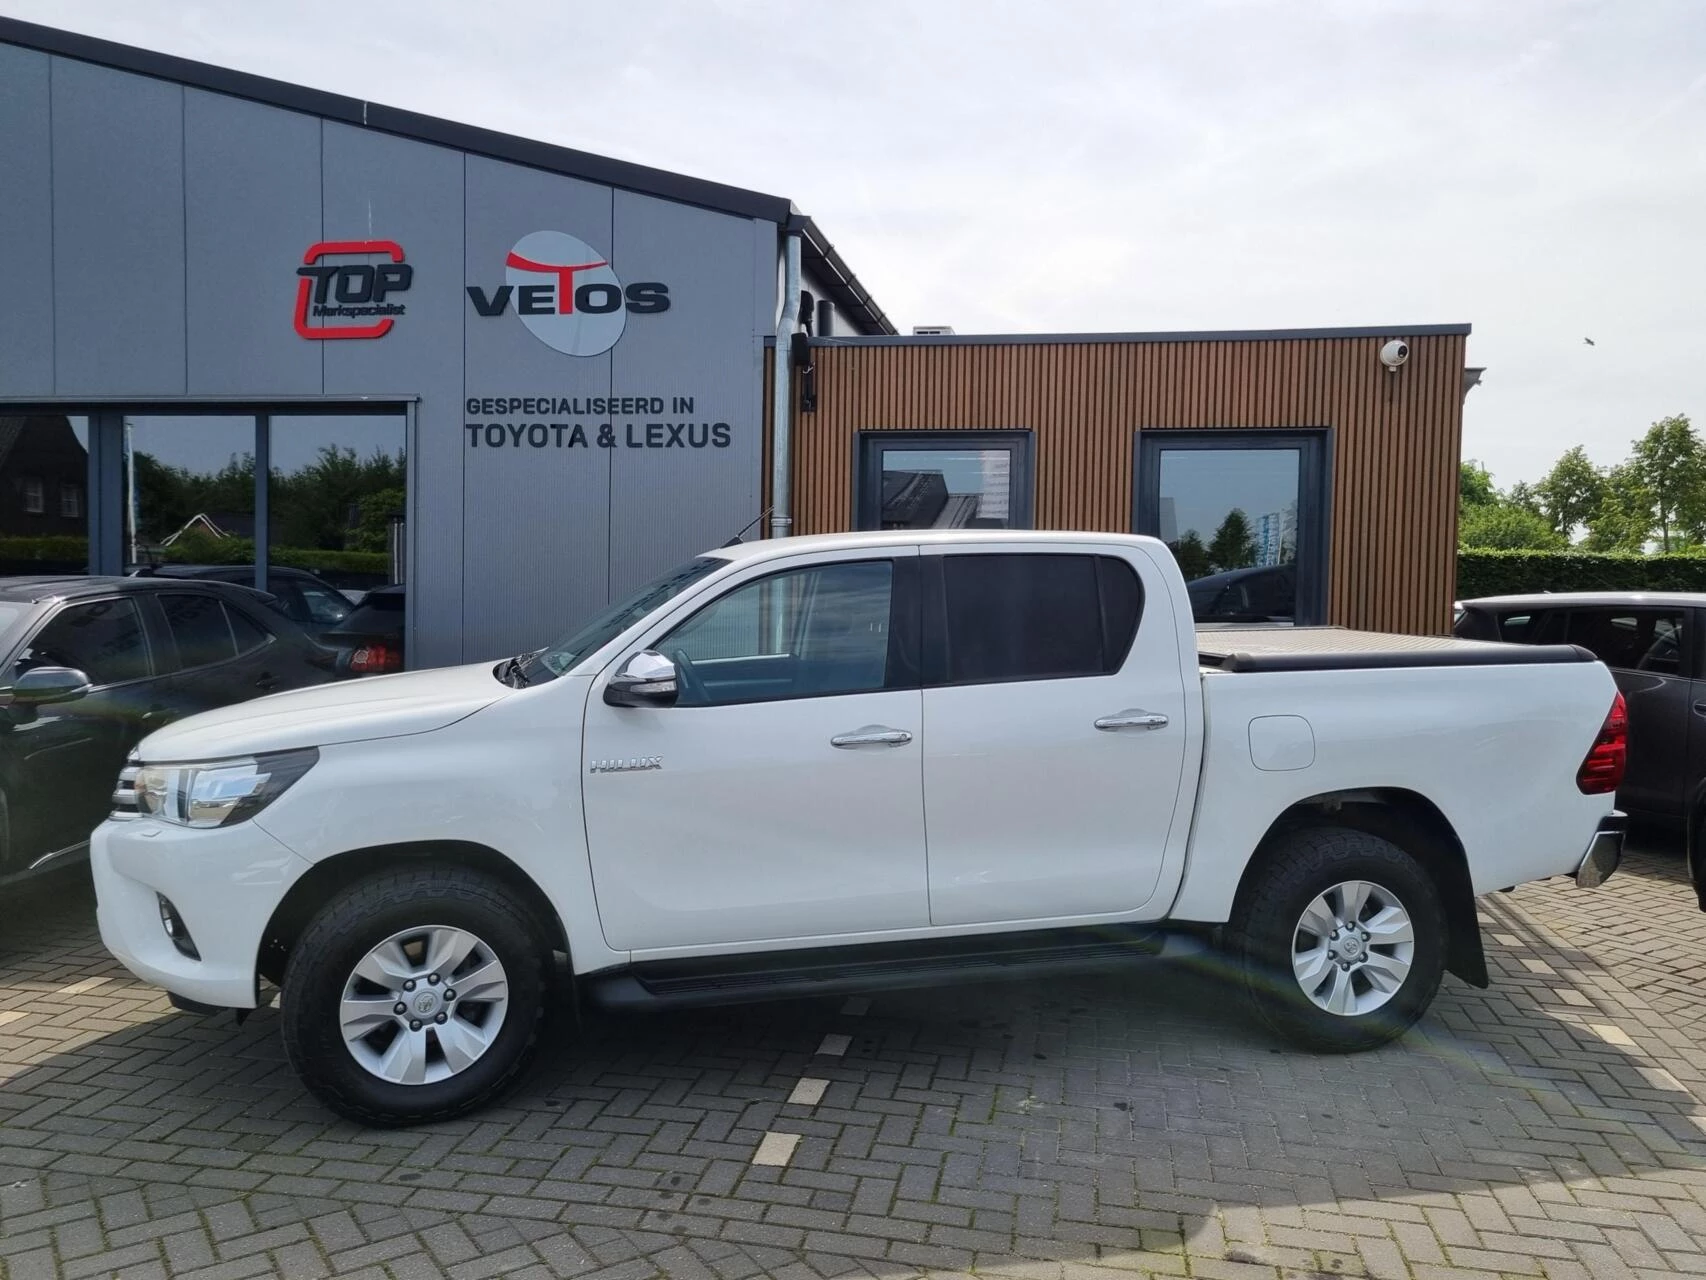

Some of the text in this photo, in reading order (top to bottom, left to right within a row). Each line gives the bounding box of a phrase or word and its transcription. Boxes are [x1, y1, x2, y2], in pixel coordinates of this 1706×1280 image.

[296, 264, 413, 304] TOP
[466, 253, 671, 316] VETOS
[466, 397, 694, 415] GESPECIALISEERD IN
[465, 422, 731, 448] TOYOTA & LEXUS
[590, 756, 663, 773] HILUX
